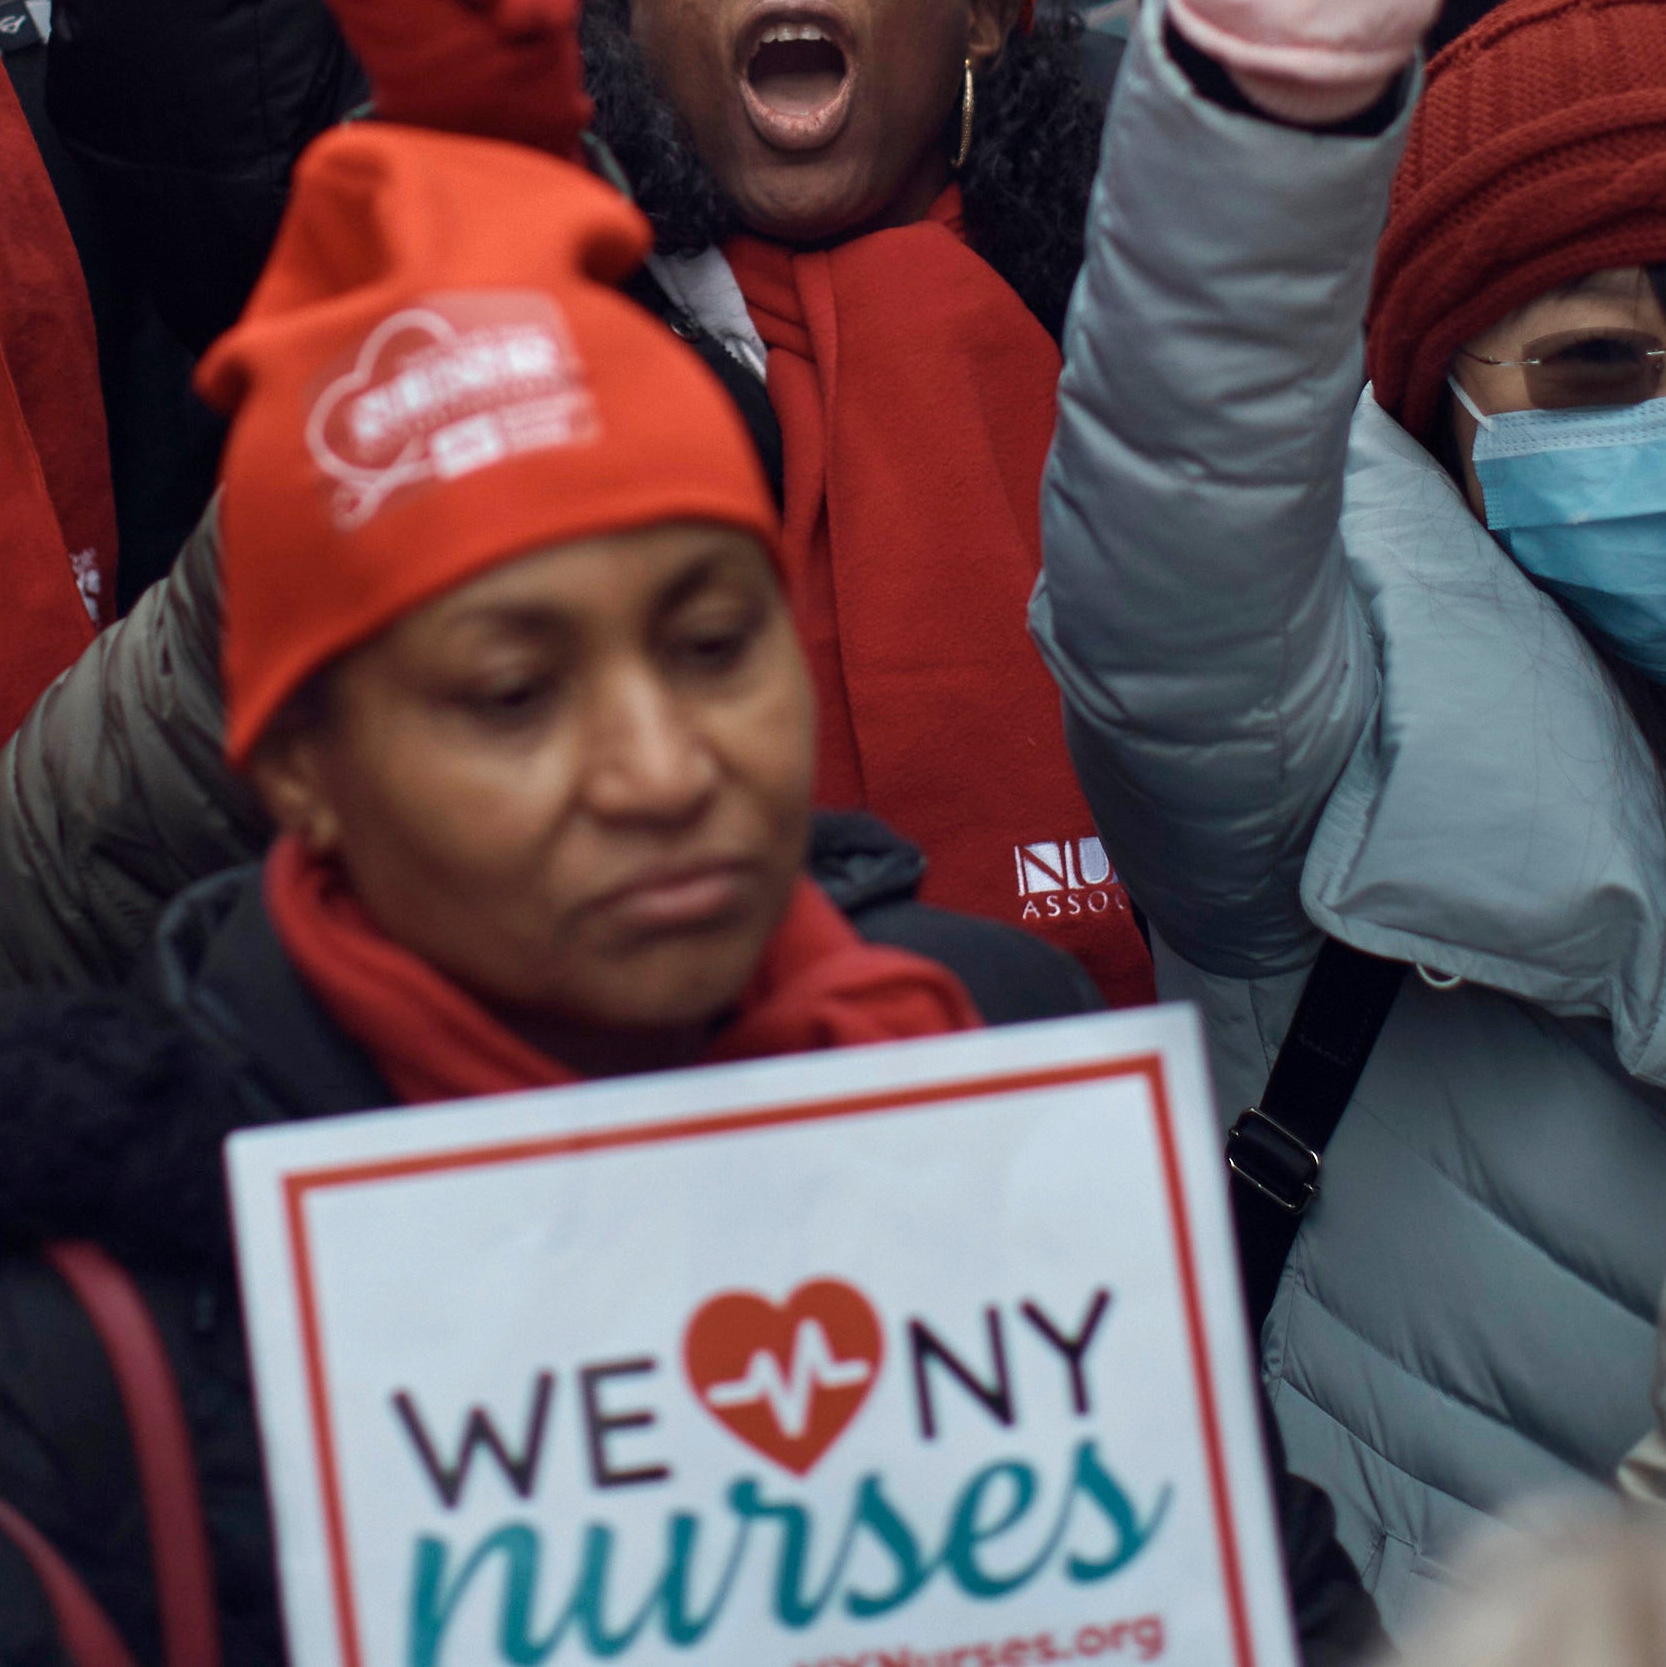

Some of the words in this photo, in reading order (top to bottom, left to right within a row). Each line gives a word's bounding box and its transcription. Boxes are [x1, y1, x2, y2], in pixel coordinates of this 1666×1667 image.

[391, 1358, 672, 1509] WE
[906, 1287, 1111, 1440] NY
[406, 1440, 1172, 1667] nurses
